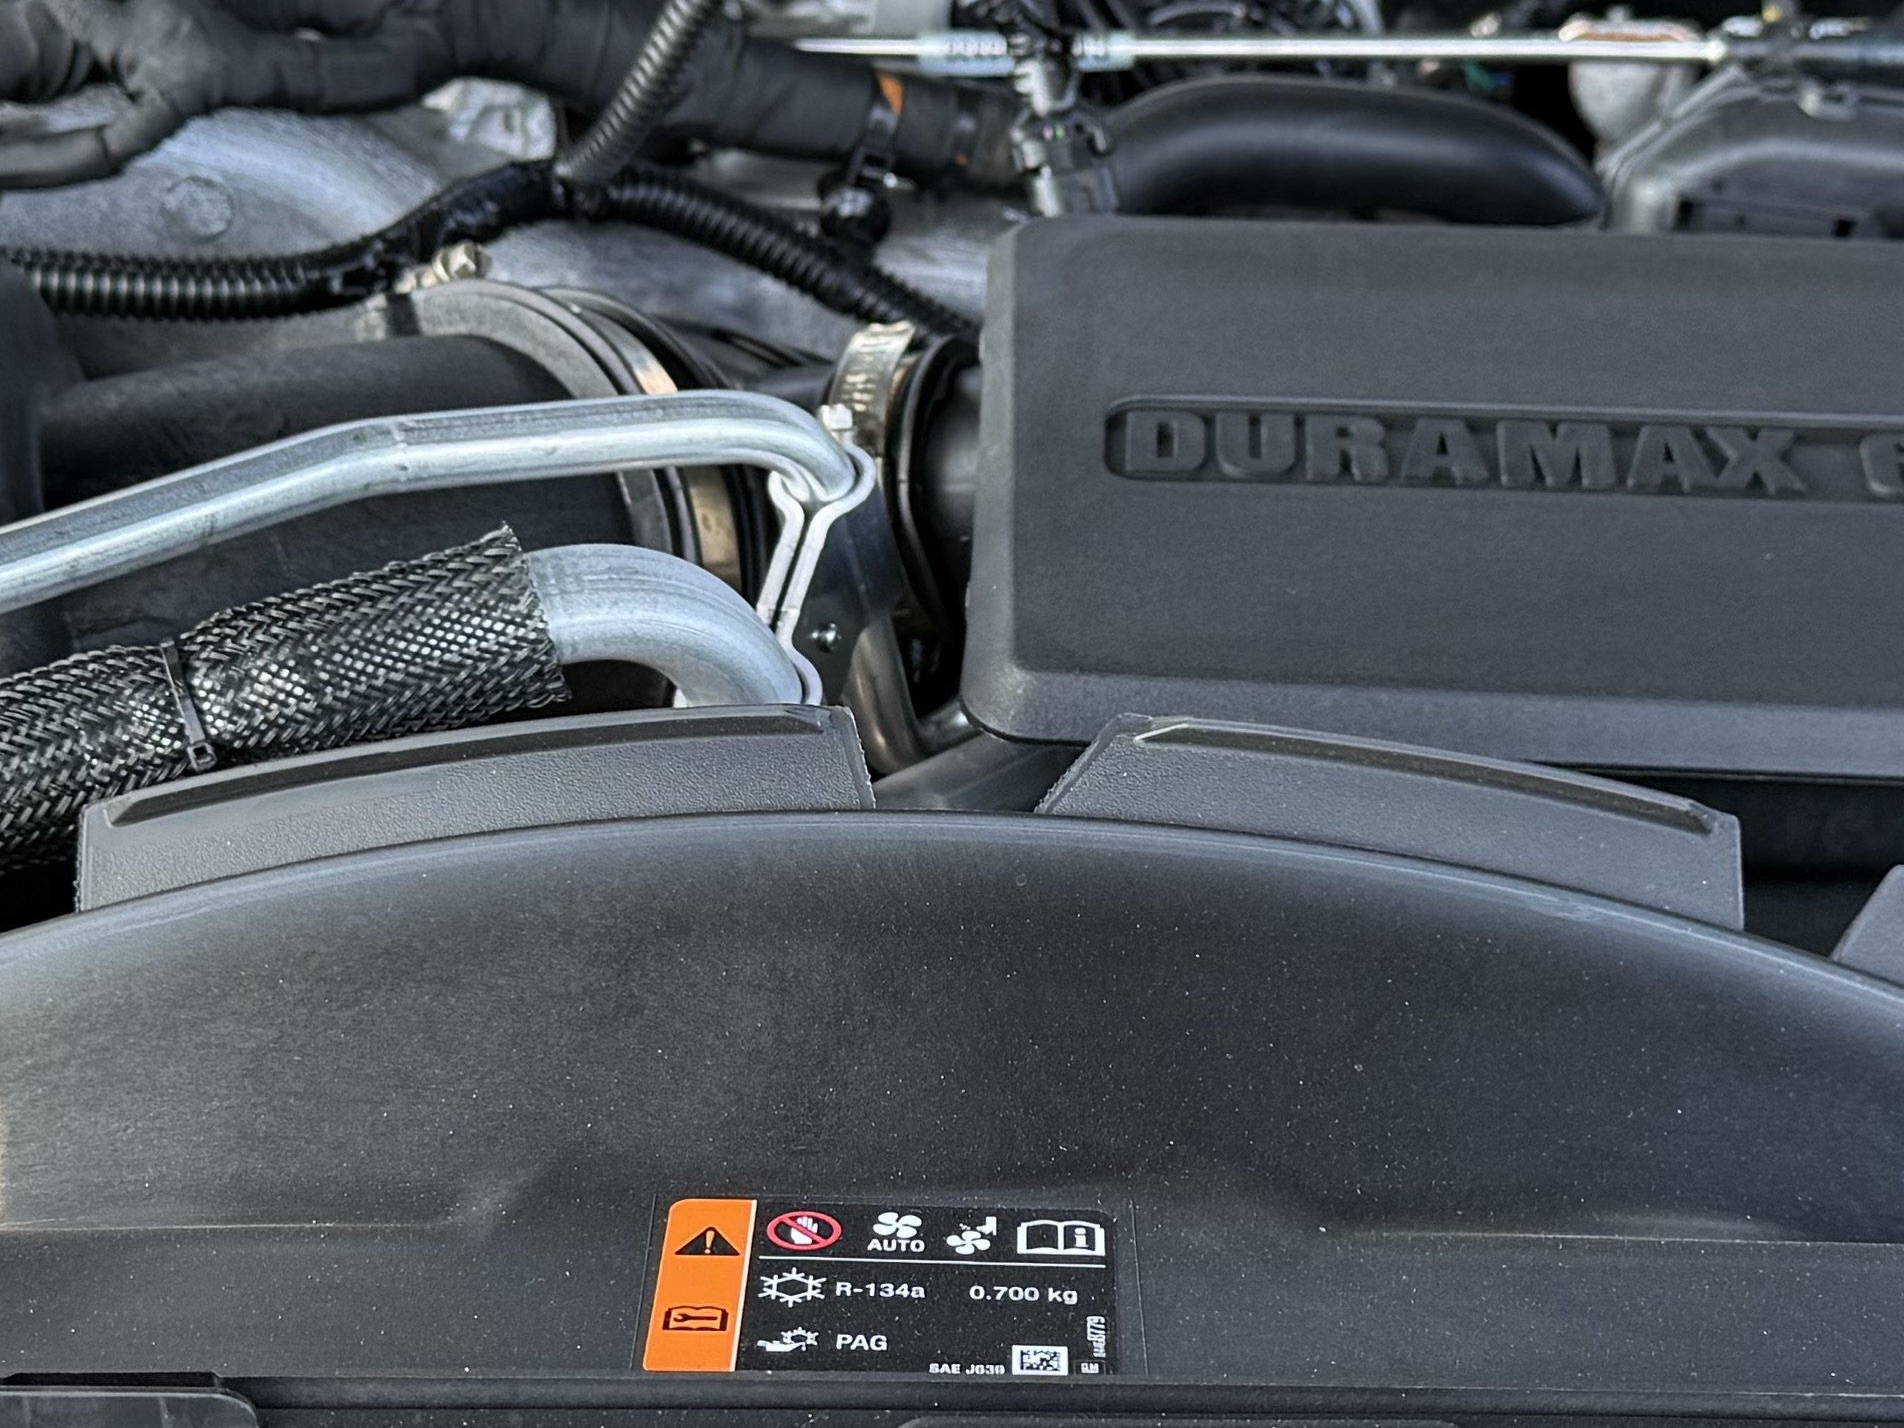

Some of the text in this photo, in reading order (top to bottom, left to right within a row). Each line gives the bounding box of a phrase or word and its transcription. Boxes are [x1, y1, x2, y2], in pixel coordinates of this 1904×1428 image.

[1123, 410, 1805, 497] DURAMAX
[867, 1238, 926, 1253] AUTO
[835, 1281, 926, 1299] R-134a
[969, 1285, 1078, 1305] 0.700 kg
[835, 1333, 888, 1352] PAG
[929, 1362, 961, 1375] SAE
